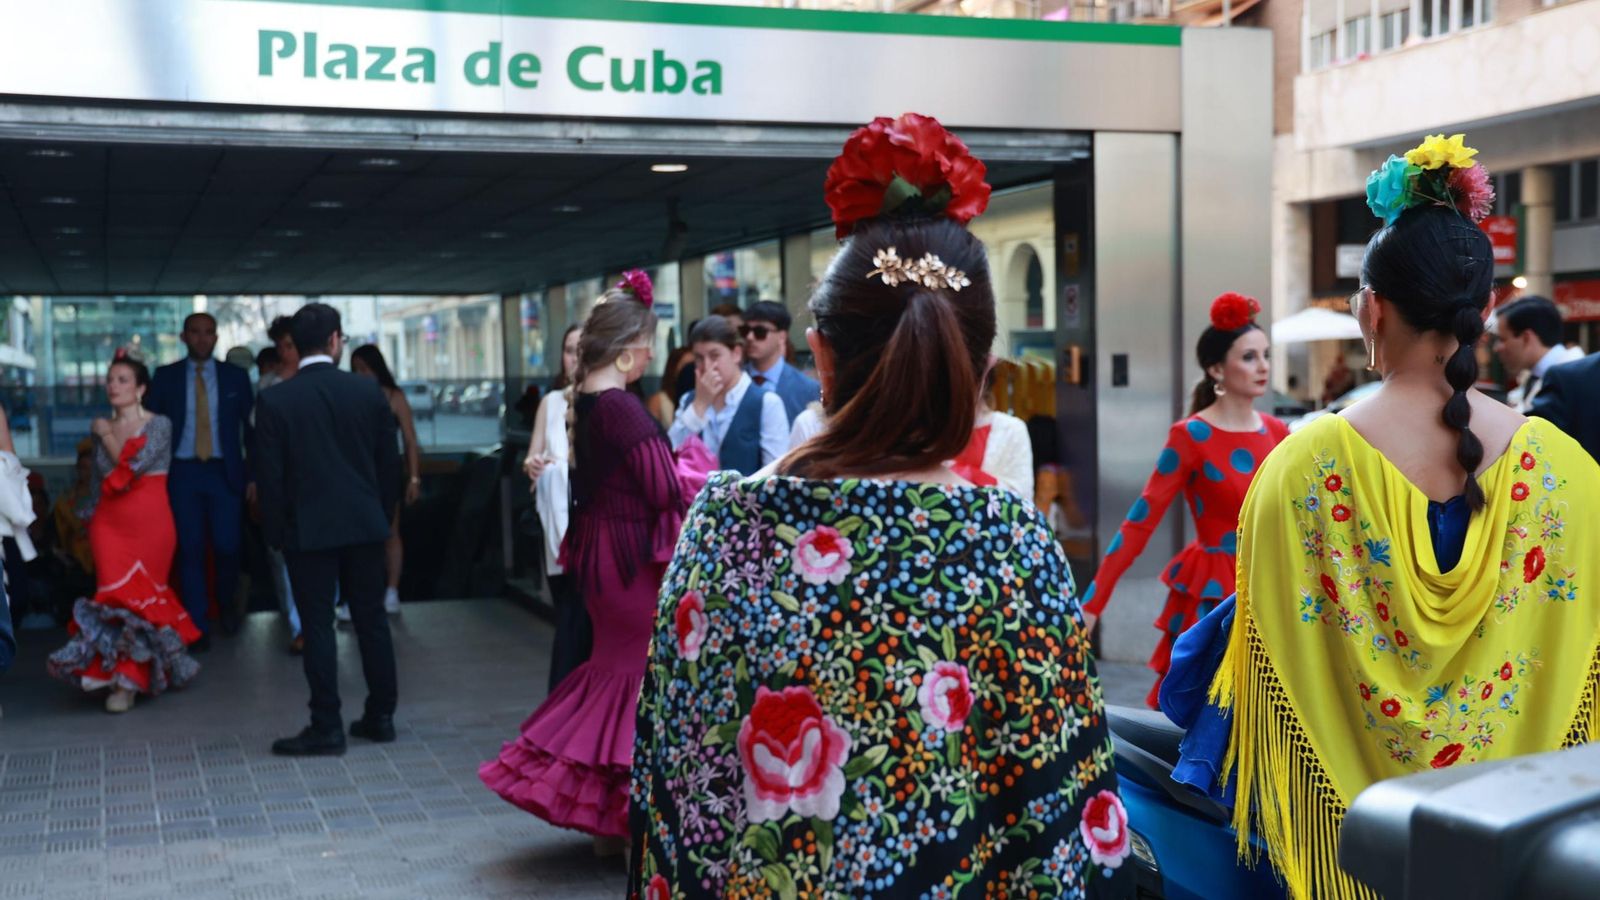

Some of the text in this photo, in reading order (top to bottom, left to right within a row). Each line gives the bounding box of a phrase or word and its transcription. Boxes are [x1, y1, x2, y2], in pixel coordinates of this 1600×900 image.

[257, 29, 724, 95] Plaza de Cuba
